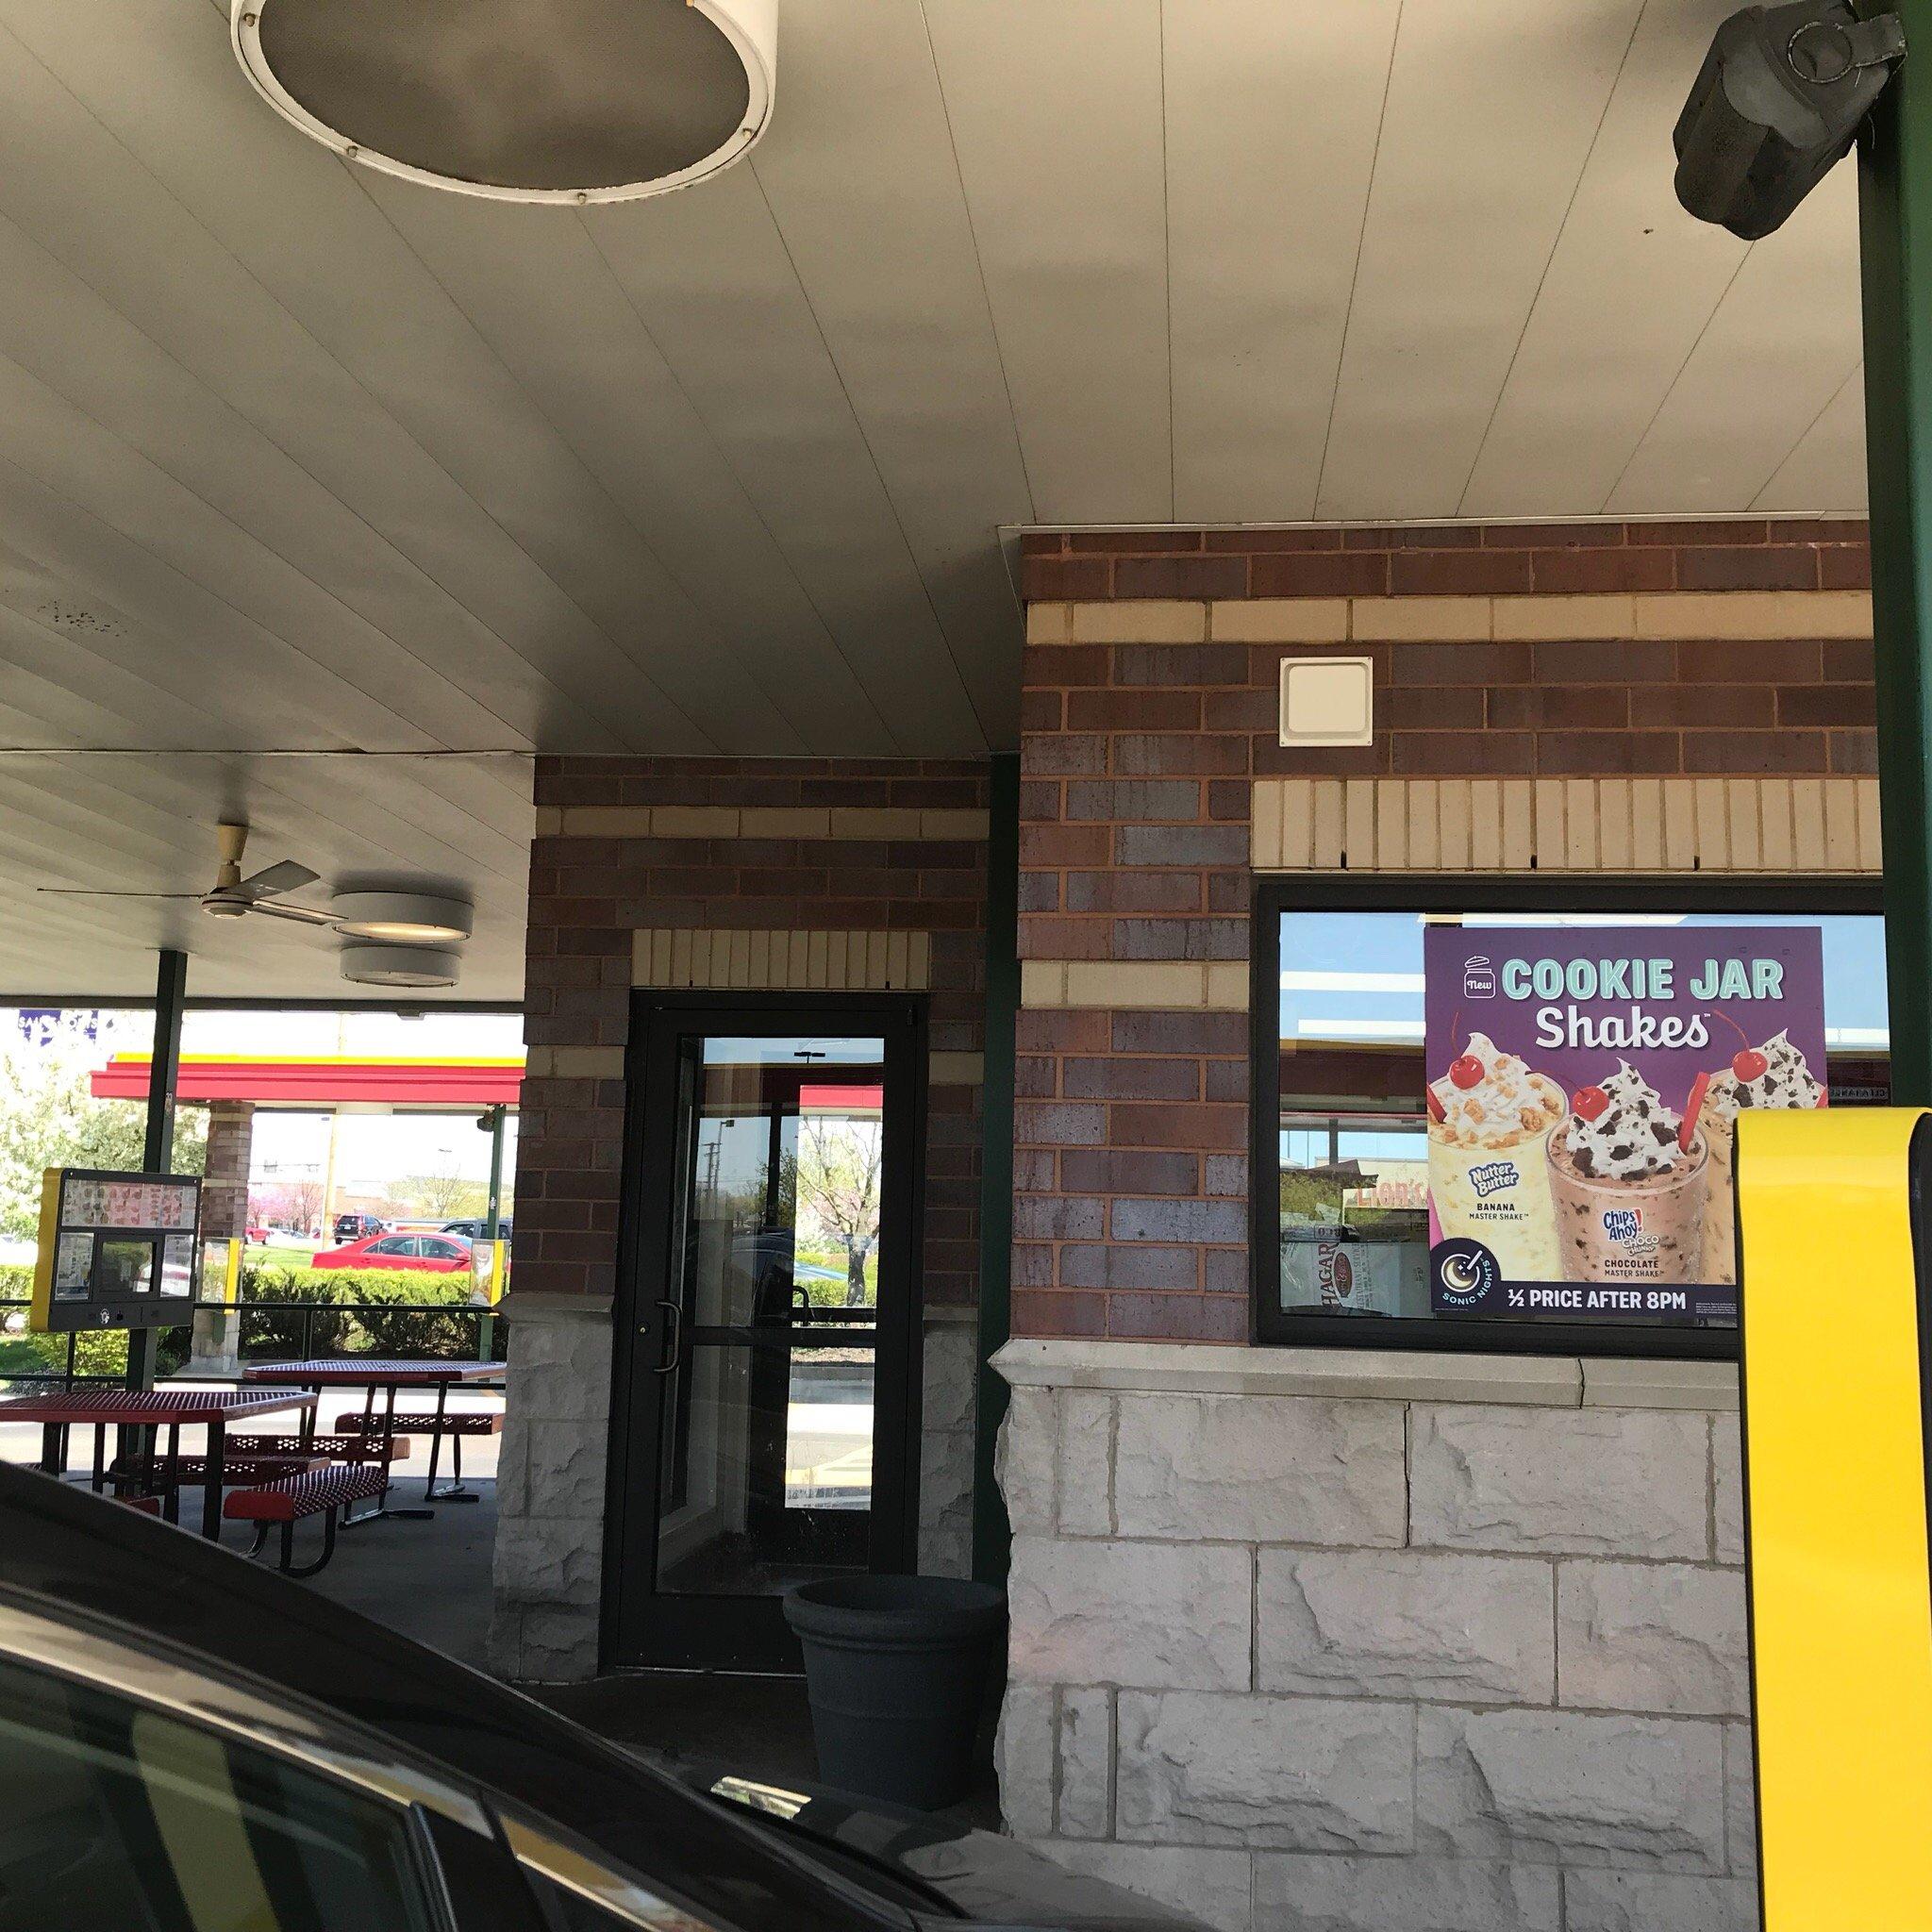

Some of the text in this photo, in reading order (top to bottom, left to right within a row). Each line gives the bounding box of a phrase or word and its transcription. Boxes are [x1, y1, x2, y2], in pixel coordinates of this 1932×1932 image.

[1467, 980, 1491, 990] New
[1502, 958, 1784, 1000] COOKIE JAR
[1470, 1163, 1513, 1185] Nutter
[1477, 1174, 1518, 1196] Butter
[1604, 1209, 1636, 1229] Chips
[1623, 1235, 1659, 1248] CHOCO
[1605, 1259, 1658, 1268] CHOCOLATE
[1442, 1259, 1492, 1306] SONIC NIGHTS
[1529, 1289, 1583, 1308] PRICE
[1587, 1291, 1642, 1309] AFTER
[1647, 1291, 1687, 1309] 8PM
